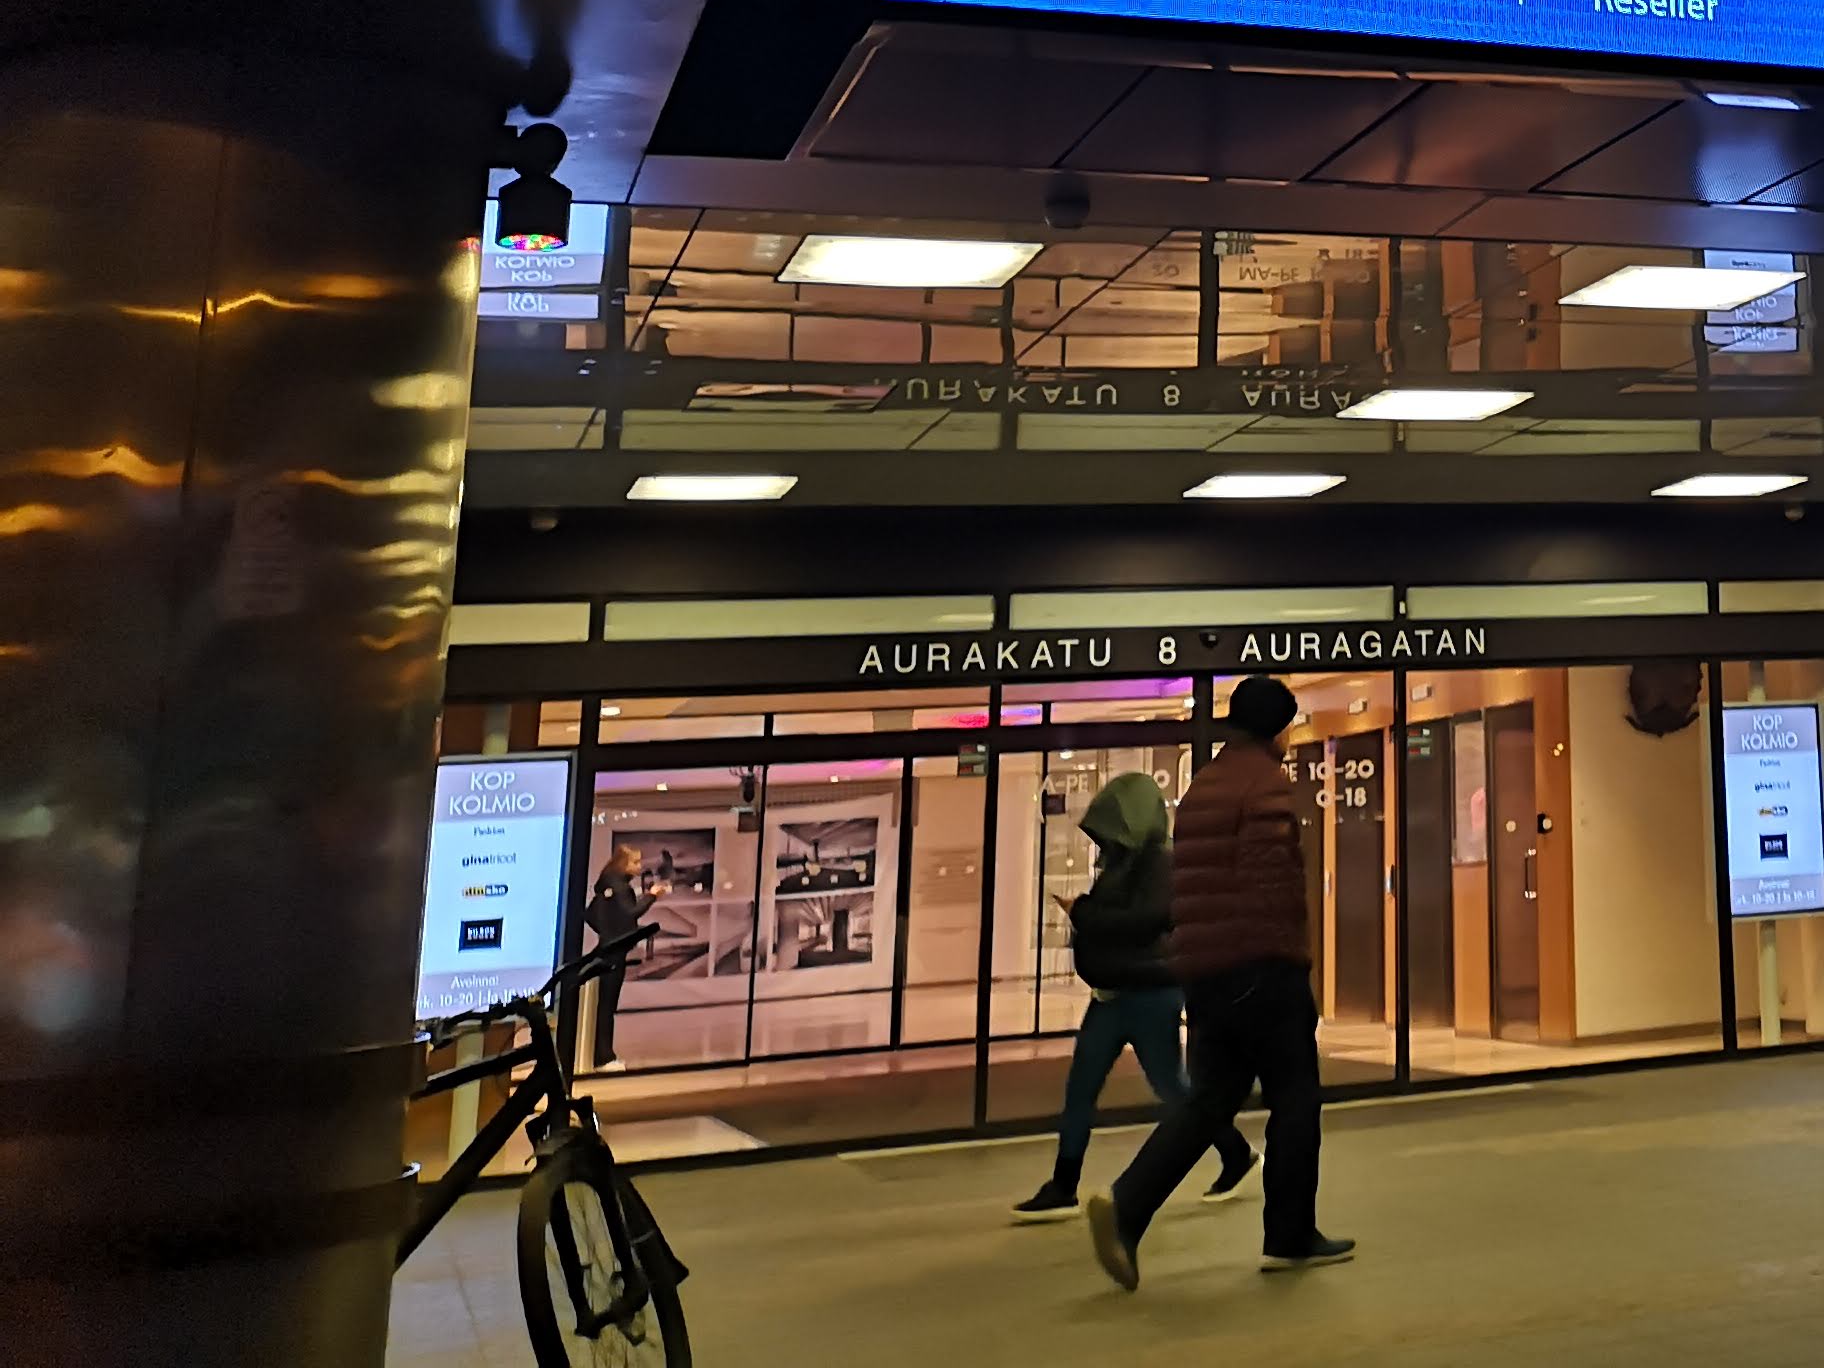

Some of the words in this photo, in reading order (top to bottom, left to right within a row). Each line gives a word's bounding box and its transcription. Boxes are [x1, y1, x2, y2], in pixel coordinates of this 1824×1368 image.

[858, 637, 1113, 676] AURAKATU
[1157, 636, 1178, 666] 8
[1239, 627, 1487, 664] AURAGATAN
[1752, 713, 1783, 732] KOP
[1740, 731, 1799, 751] KOLMIO
[470, 770, 516, 792] KOP
[1307, 758, 1376, 782] 10-20
[449, 791, 536, 817] KOLMIO
